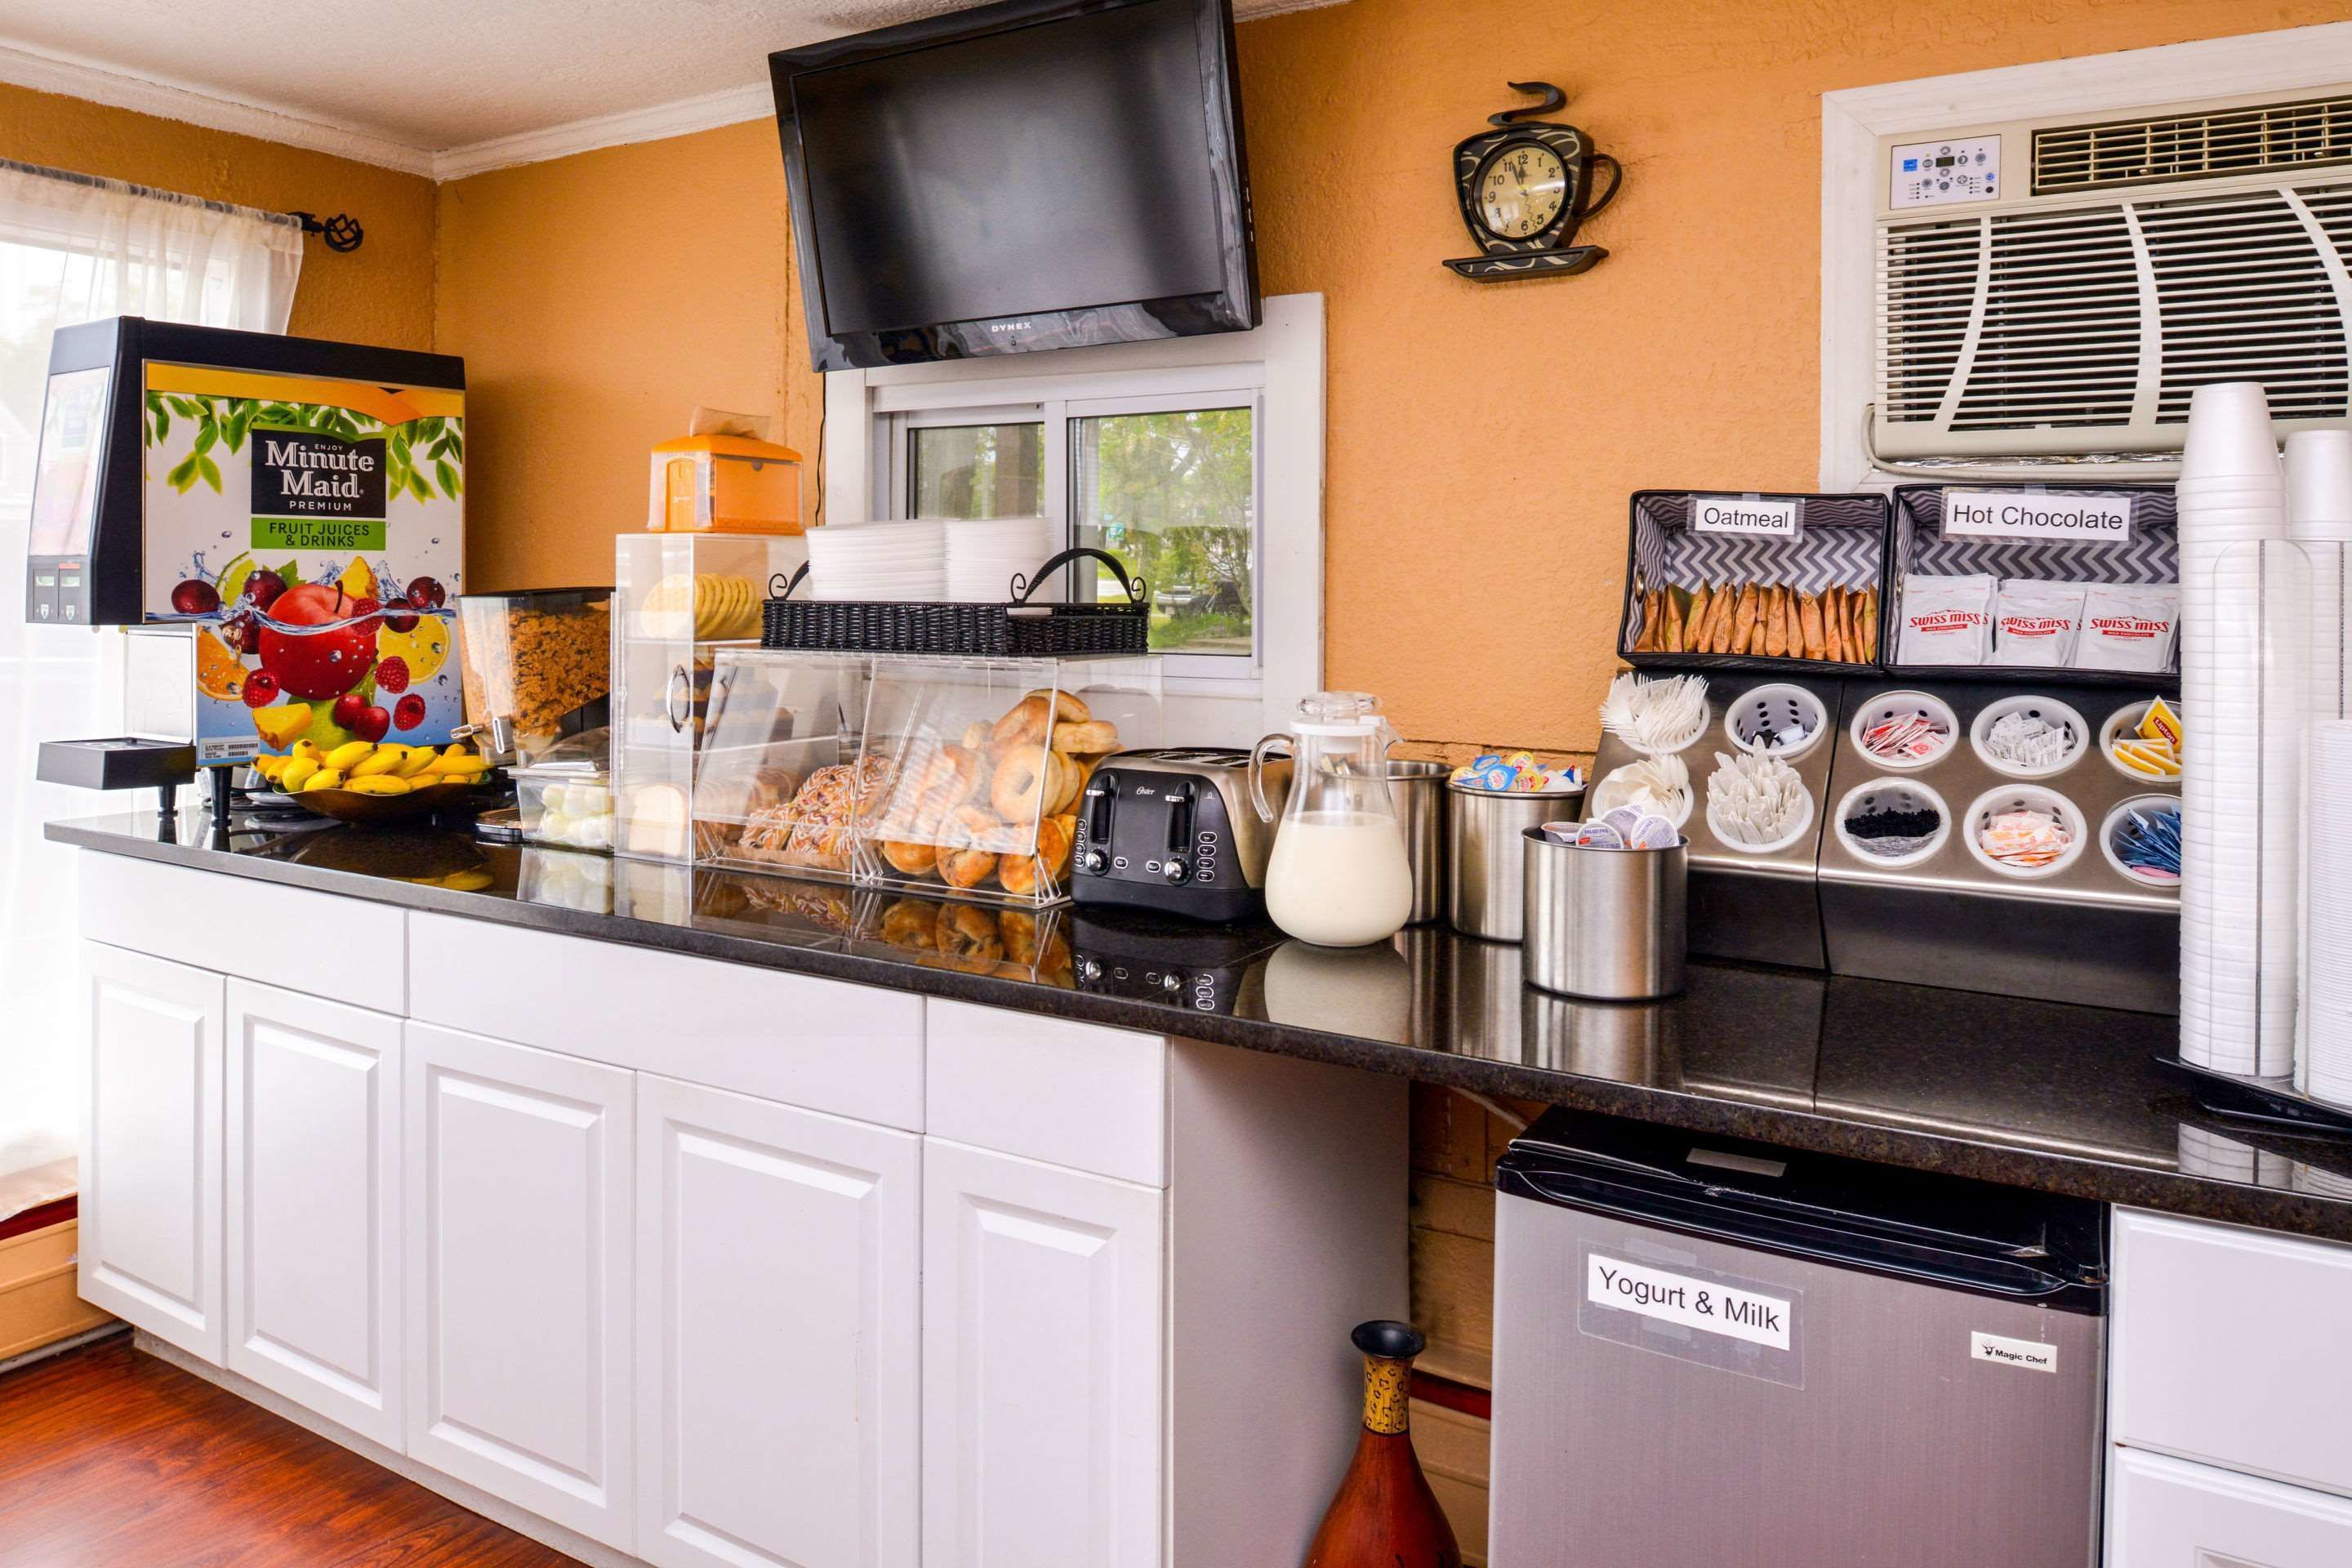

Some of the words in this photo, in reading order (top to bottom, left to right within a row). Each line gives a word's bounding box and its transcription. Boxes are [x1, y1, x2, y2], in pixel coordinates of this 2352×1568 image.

[1518, 154, 1529, 165] 12
[1548, 167, 1556, 178] 2
[1492, 175, 1504, 185] 10
[1488, 191, 1496, 203] 9
[1548, 201, 1557, 212] 4
[1536, 213, 1544, 225] 5
[1521, 220, 1529, 231] 6
[991, 322, 1032, 332] DYNEX
[265, 440, 375, 471] Minute
[280, 469, 360, 498] Maid
[289, 501, 352, 511] PREMIUM
[1704, 507, 1788, 528] Oatmeal
[1953, 504, 1993, 524] Hot
[2002, 506, 2123, 530] Chocolate
[270, 522, 314, 535] FRUIT
[318, 523, 370, 536] JUICES
[286, 534, 296, 546] &
[301, 535, 355, 547] DRINKS
[2154, 718, 2176, 743] Lipton
[1599, 1266, 1686, 1305] Yogurt
[1695, 1291, 1714, 1316] &
[1725, 1297, 1780, 1332] Milk
[1995, 1349, 2023, 1361] Magic
[2025, 1355, 2047, 1365] Chef
